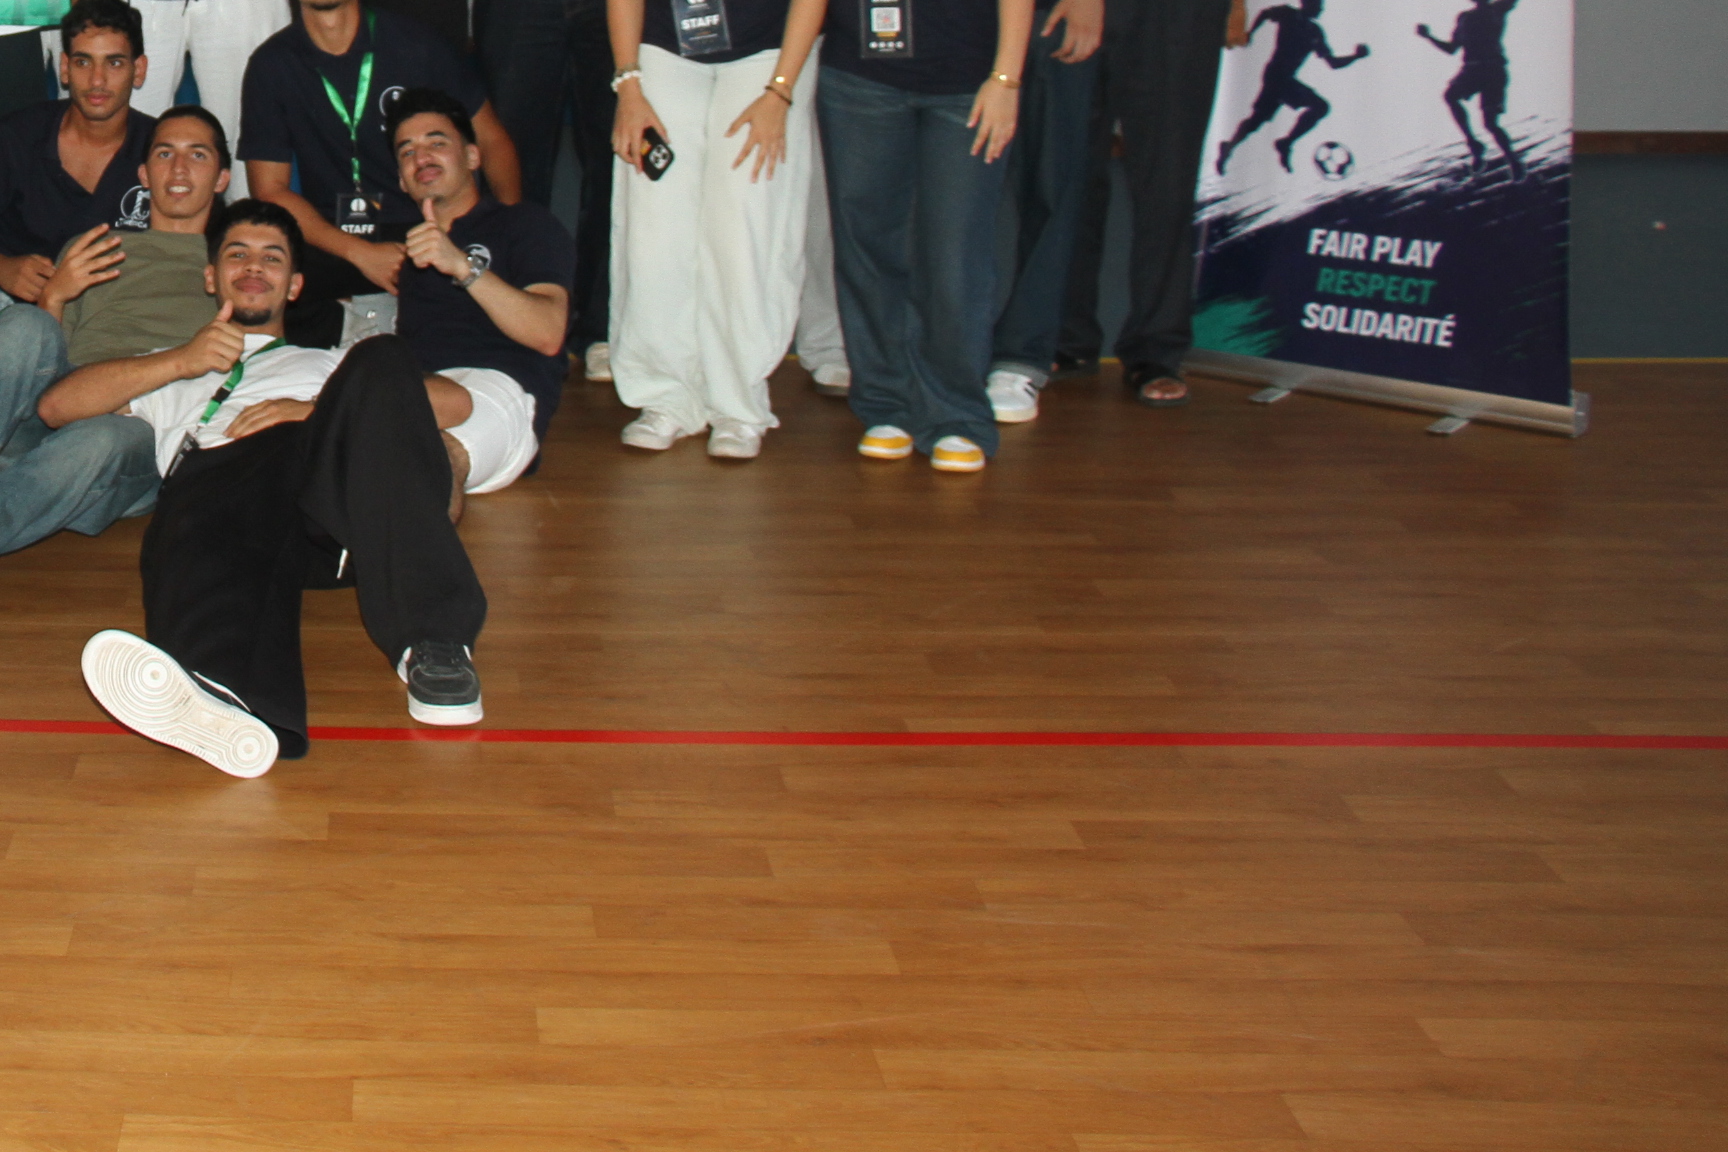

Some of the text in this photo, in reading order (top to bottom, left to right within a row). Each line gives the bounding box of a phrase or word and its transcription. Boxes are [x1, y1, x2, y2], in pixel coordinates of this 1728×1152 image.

[680, 14, 720, 30] STAFF
[341, 223, 375, 235] STAFF
[1307, 228, 1442, 268] FAIR PLAY
[1316, 267, 1437, 306] RESPECT
[1302, 302, 1456, 347] SOLIDARITÉ
